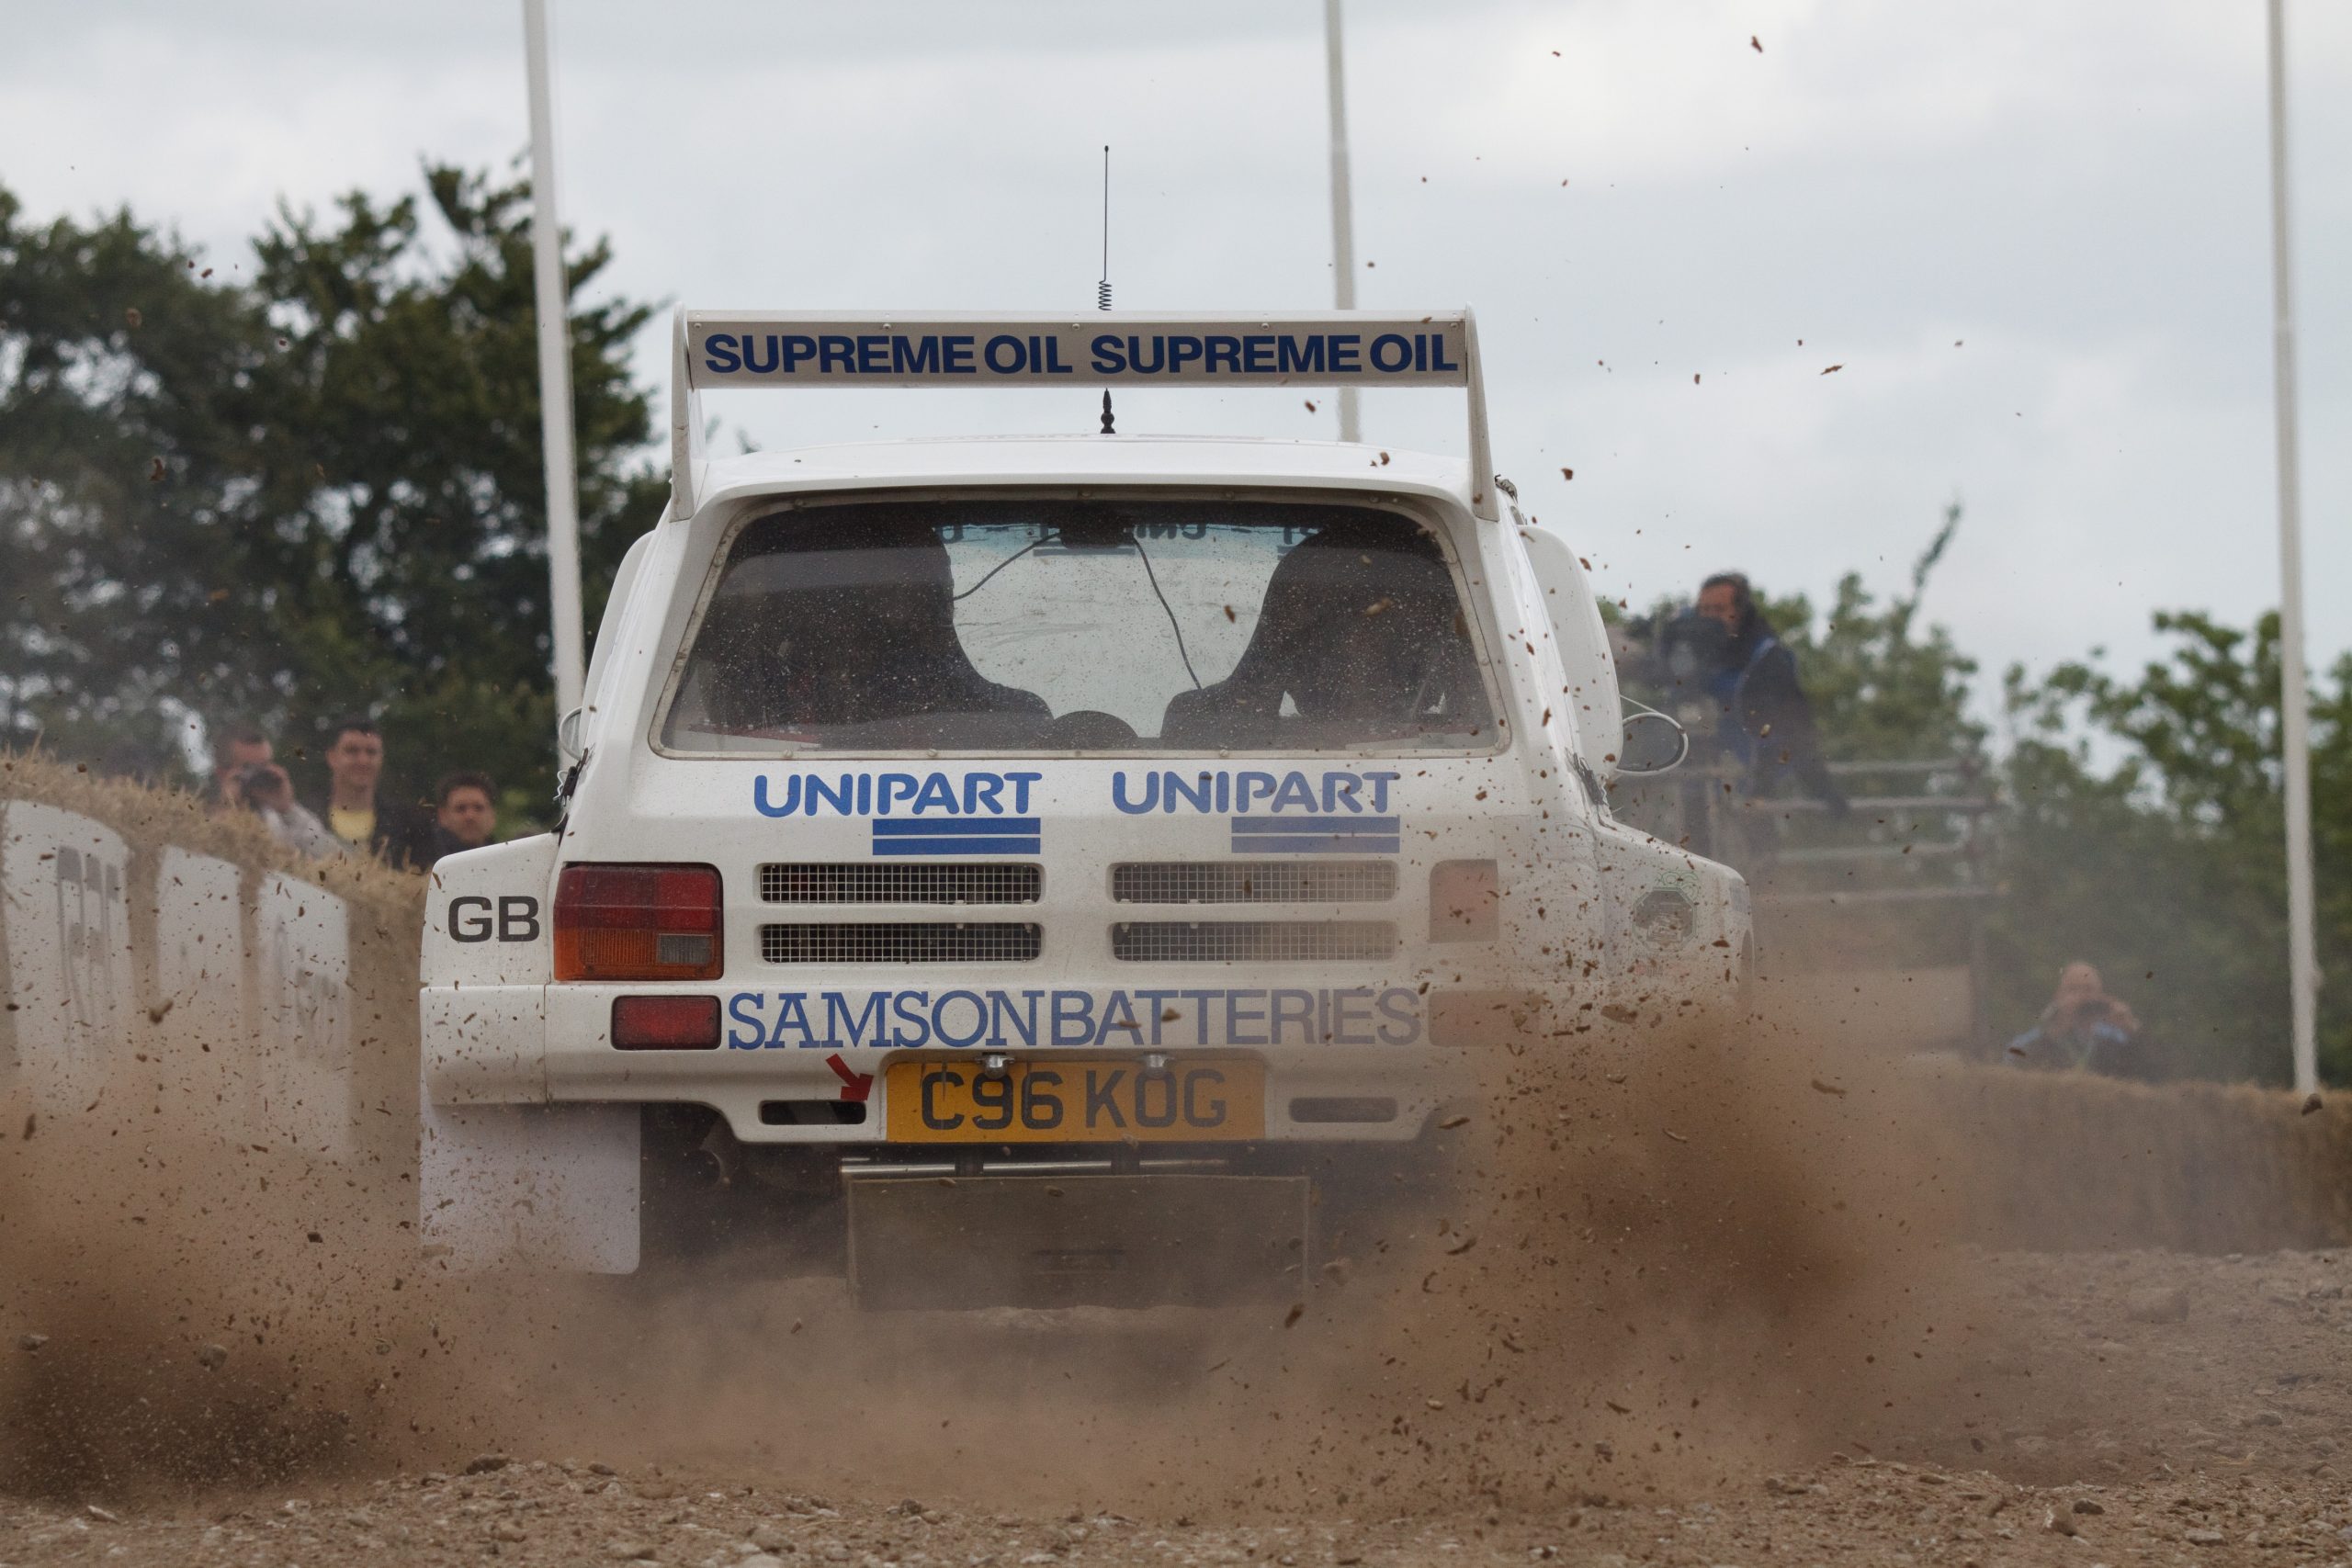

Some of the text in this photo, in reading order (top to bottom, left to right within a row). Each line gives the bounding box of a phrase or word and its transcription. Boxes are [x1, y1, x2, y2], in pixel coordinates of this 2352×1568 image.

[705, 333, 1074, 374] SUPREME OIL
[1091, 333, 1457, 374] SUPREME OIL
[753, 771, 1043, 818] UNIPART
[1112, 770, 1402, 815] UNIPART
[447, 896, 540, 943] GB
[921, 1068, 1227, 1131] C96 KOG
